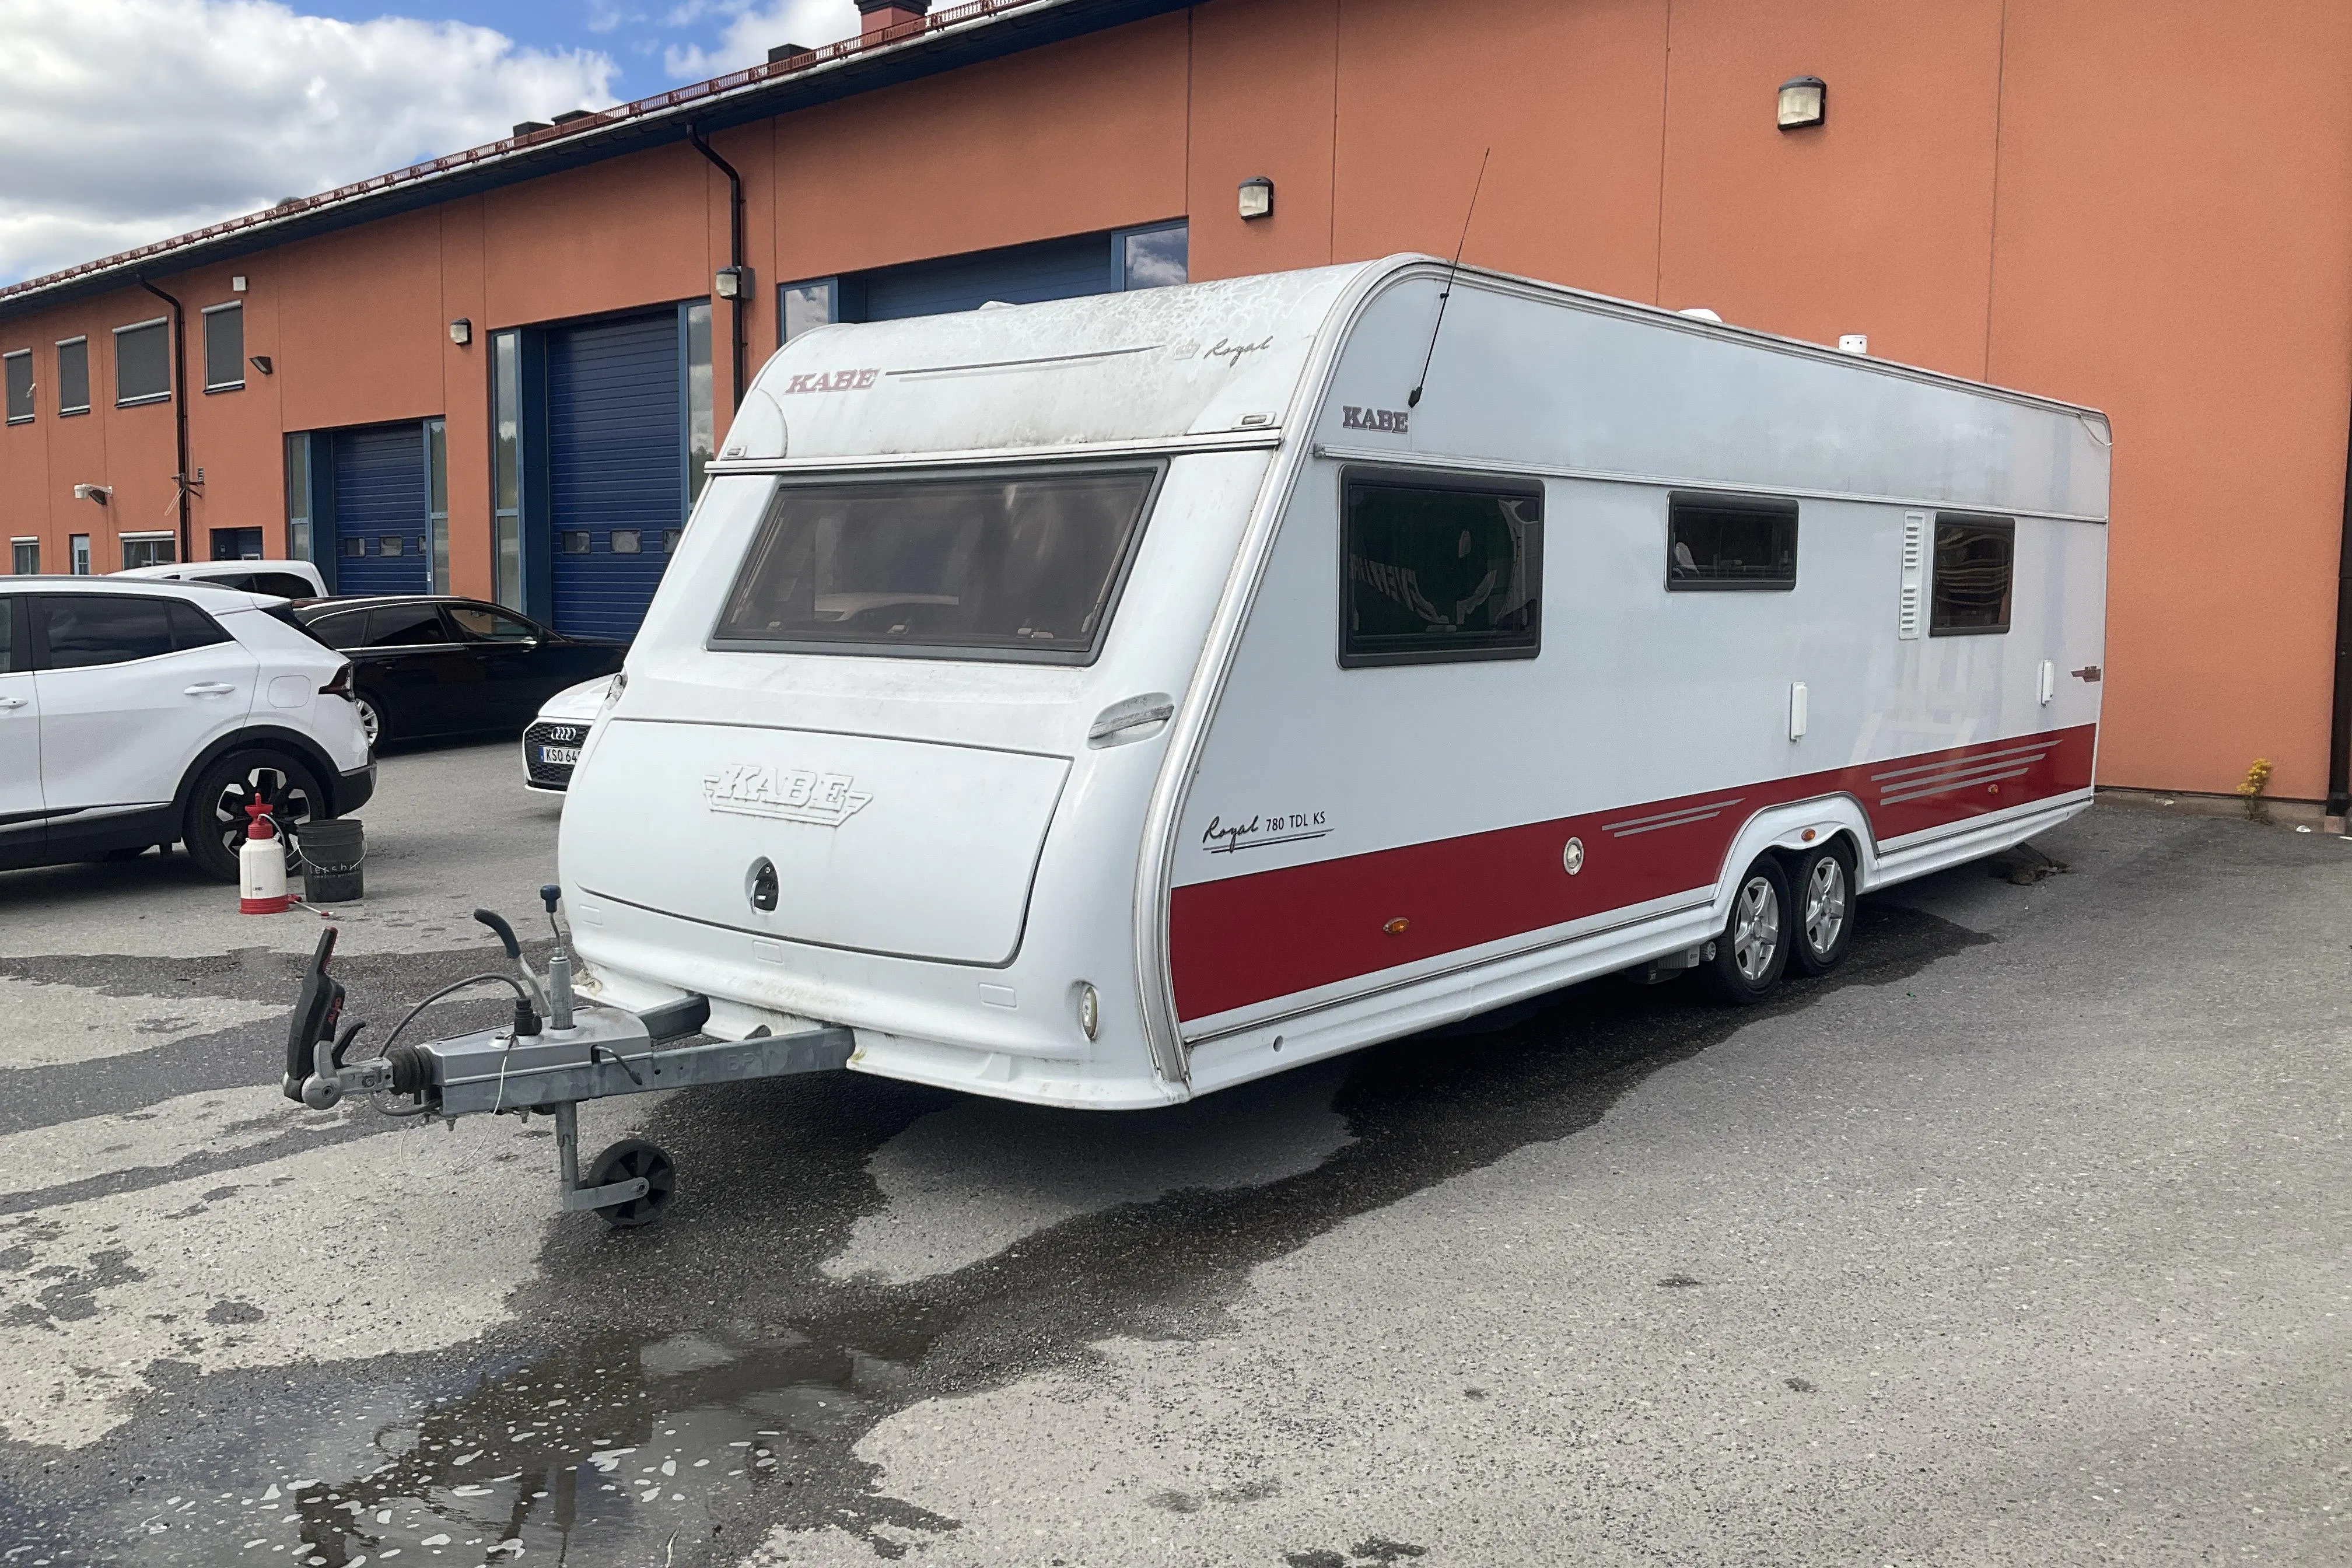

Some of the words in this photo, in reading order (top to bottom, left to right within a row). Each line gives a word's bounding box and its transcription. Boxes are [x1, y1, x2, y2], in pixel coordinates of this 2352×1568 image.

[1203, 335, 1273, 368] Royal
[784, 368, 881, 395] KABE
[1343, 405, 1409, 434] KABE
[546, 748, 563, 762] KSO
[566, 750, 581, 762] 64
[715, 763, 854, 813] KABE
[1202, 815, 1259, 853] Royal
[1266, 817, 1284, 832] 780
[1289, 813, 1308, 828] TDL
[1313, 811, 1325, 825] KS
